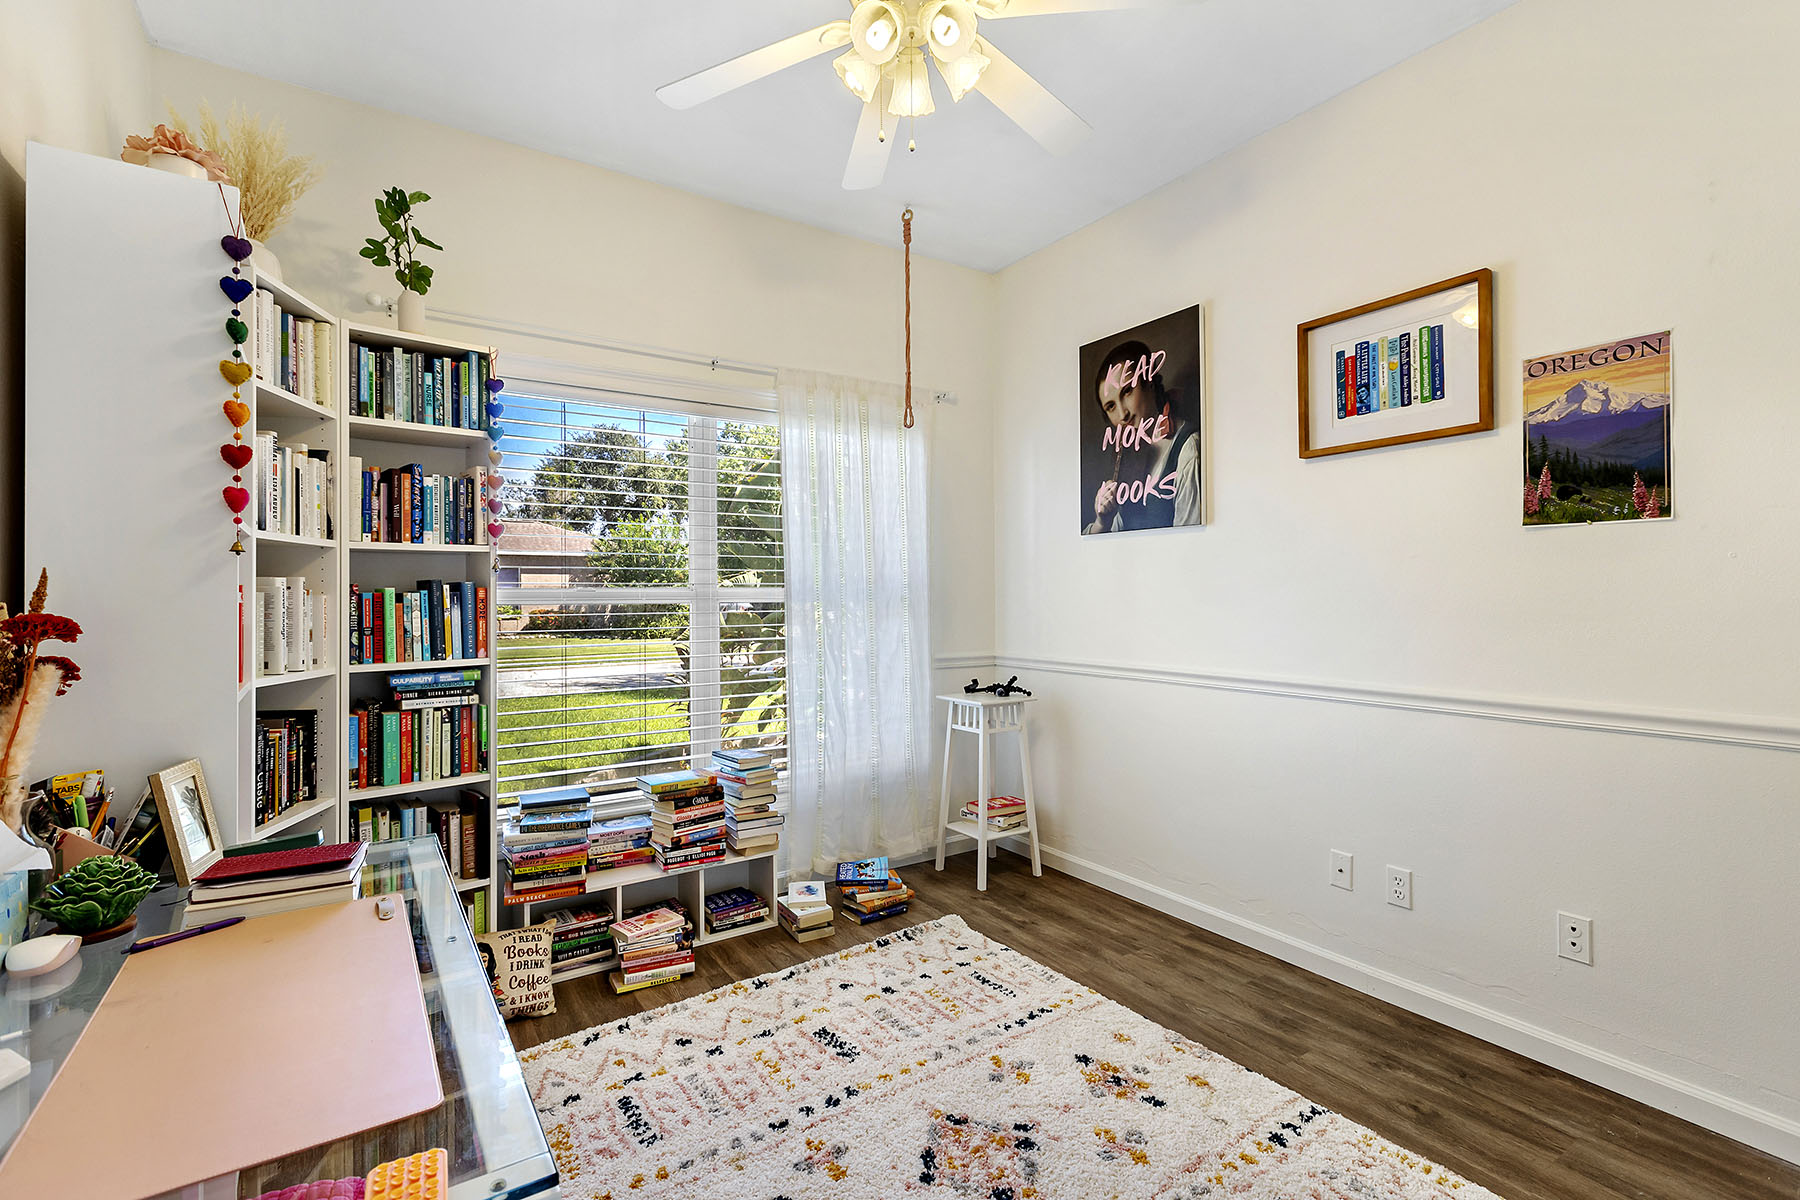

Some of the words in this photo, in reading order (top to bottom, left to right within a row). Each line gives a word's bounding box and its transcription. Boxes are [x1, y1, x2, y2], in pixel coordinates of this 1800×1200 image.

[1401, 335, 1409, 347] The
[1401, 348, 1409, 364] Push
[1527, 337, 1664, 378] OREGON
[1104, 350, 1166, 397] READ
[1102, 414, 1169, 453] MORE
[1097, 471, 1178, 514] BOOKS
[392, 676, 432, 685] CULPABILITY
[55, 784, 80, 794] TABS
[256, 772, 264, 809] Caste
[519, 851, 546, 862] Stash
[498, 930, 521, 941] THAT'S
[512, 936, 517, 944] I
[518, 934, 543, 944] READ
[504, 943, 550, 960] Books
[557, 952, 573, 961] WILD
[574, 947, 590, 956] FAITH
[509, 961, 514, 972] I
[516, 959, 545, 971] DRINK
[508, 974, 550, 992] Coffee
[650, 977, 671, 986] RESPECT
[509, 996, 517, 1006] &
[518, 994, 523, 1004] I
[524, 990, 550, 1002] KNOW
[509, 1000, 550, 1015] THINGS
